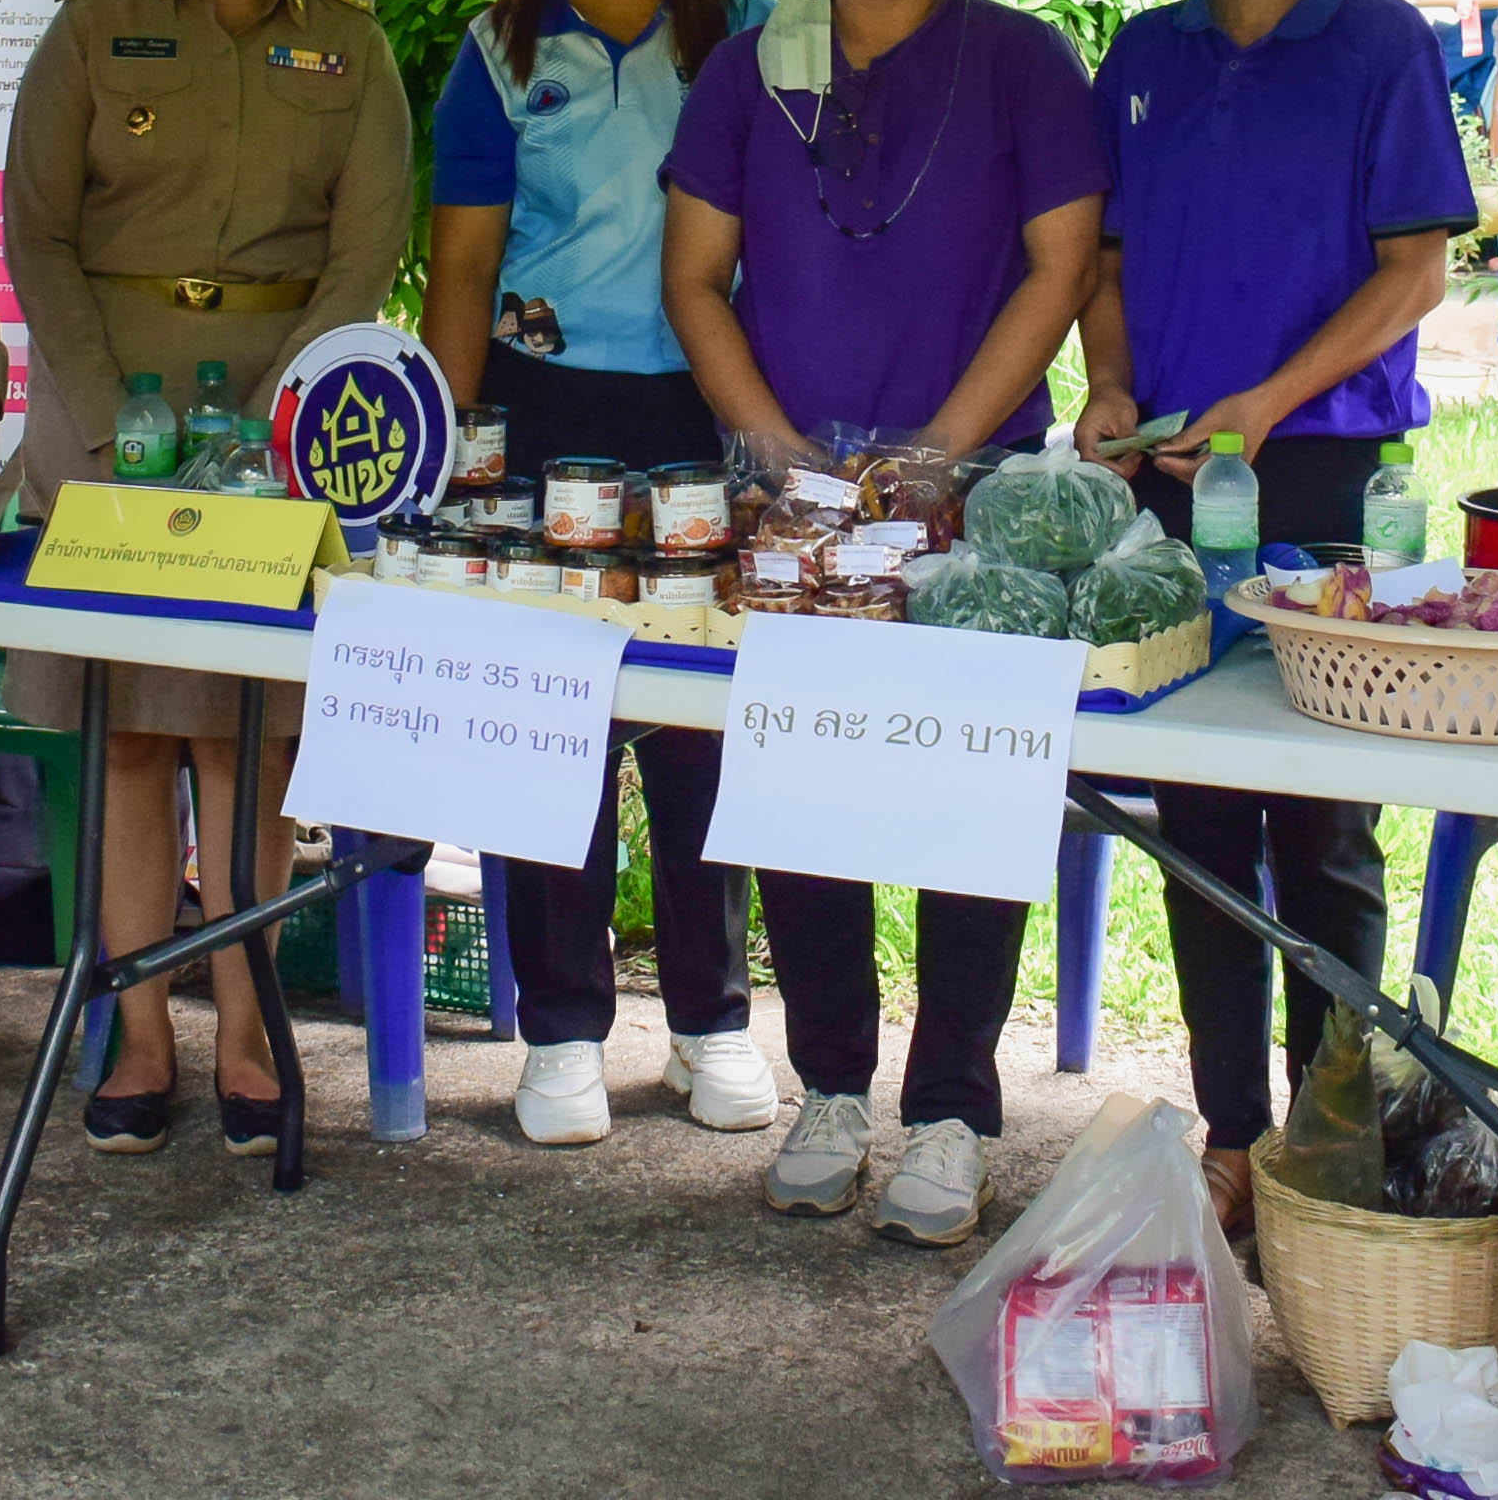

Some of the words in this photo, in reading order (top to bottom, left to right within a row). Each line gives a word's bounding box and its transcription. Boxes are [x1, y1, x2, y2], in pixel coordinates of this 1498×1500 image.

[44, 537, 302, 577] สำนักงานพัฒนาชุมชนอำเภอนาหมื่น
[334, 642, 423, 684] กระปุก
[435, 658, 471, 681] ละ
[483, 662, 519, 688] 35
[531, 671, 590, 700] บาท
[321, 695, 339, 717] 3
[350, 701, 439, 743] กระปุก
[466, 718, 518, 746] 100
[529, 729, 589, 758] บาท
[744, 701, 795, 748] ถุง
[814, 708, 868, 740] ละ
[885, 712, 942, 748] 20
[960, 723, 1052, 760] บาท
